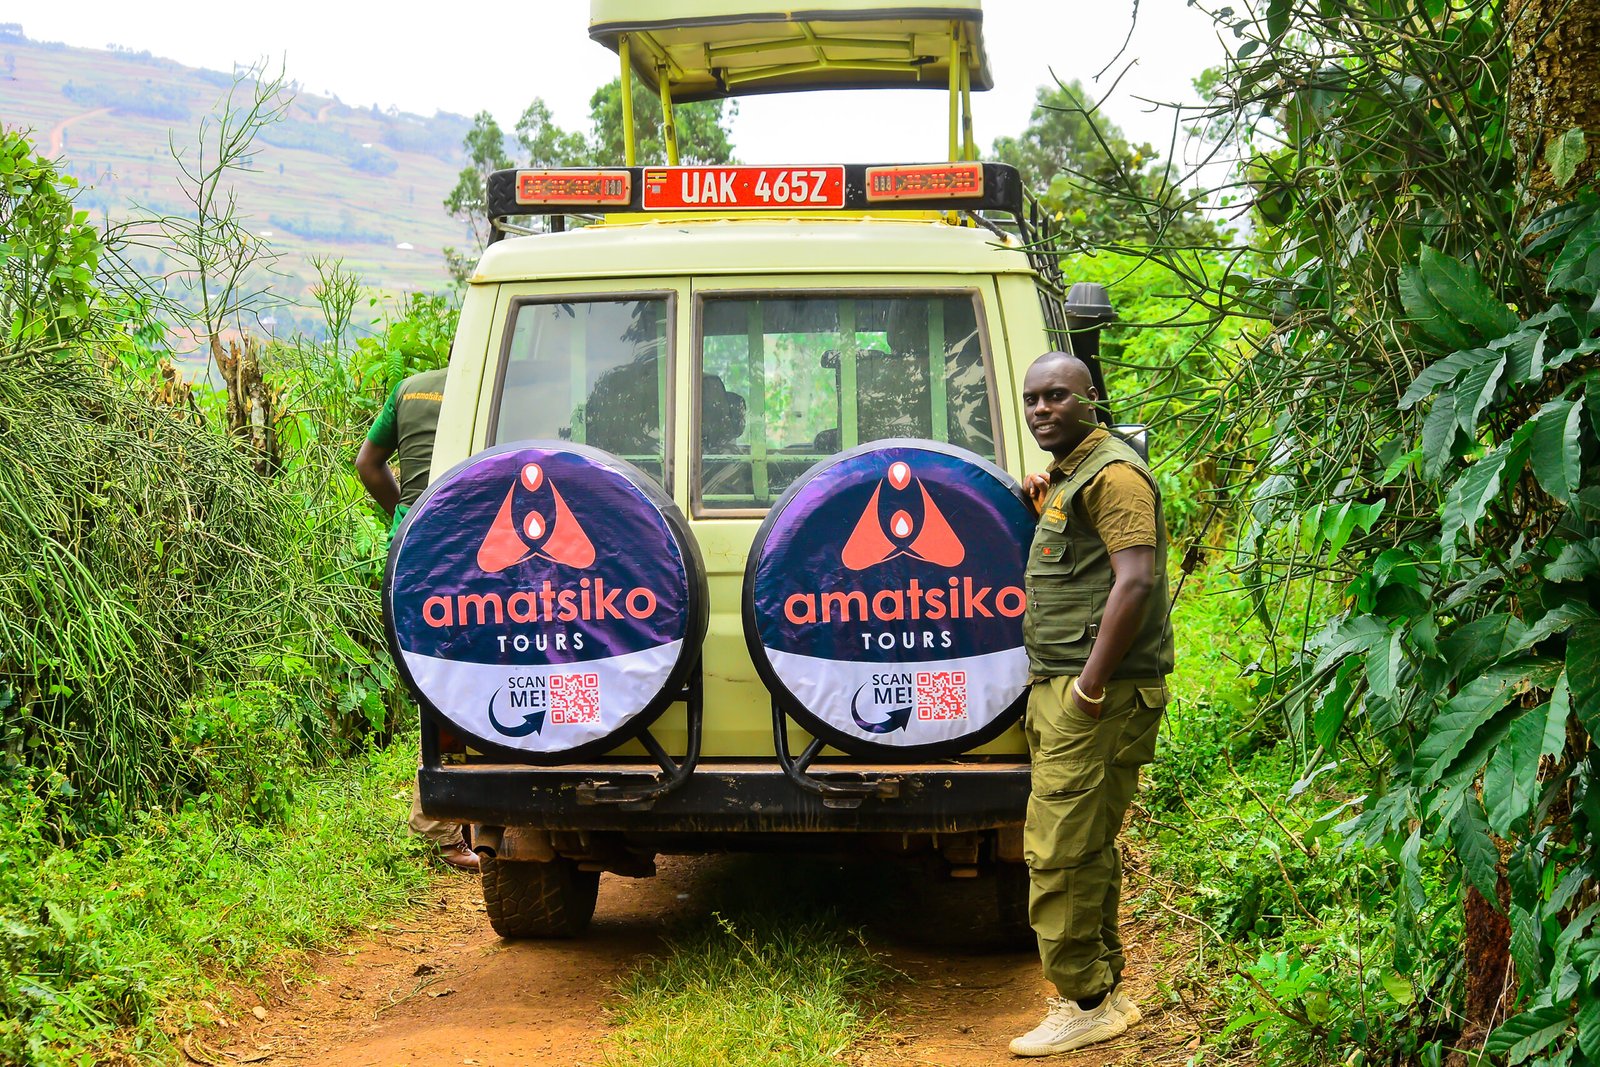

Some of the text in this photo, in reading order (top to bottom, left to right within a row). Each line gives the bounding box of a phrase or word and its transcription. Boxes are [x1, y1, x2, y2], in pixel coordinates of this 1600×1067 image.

[681, 170, 828, 203] UAK 465Z
[422, 577, 657, 628] amatsiko
[784, 576, 1027, 625] amatsiko
[497, 632, 584, 653] TOURS
[861, 630, 952, 650] TOURS
[508, 676, 546, 689] SCAN
[872, 672, 912, 686] SCAN
[510, 689, 547, 708] ME!
[874, 686, 913, 705] ME!
